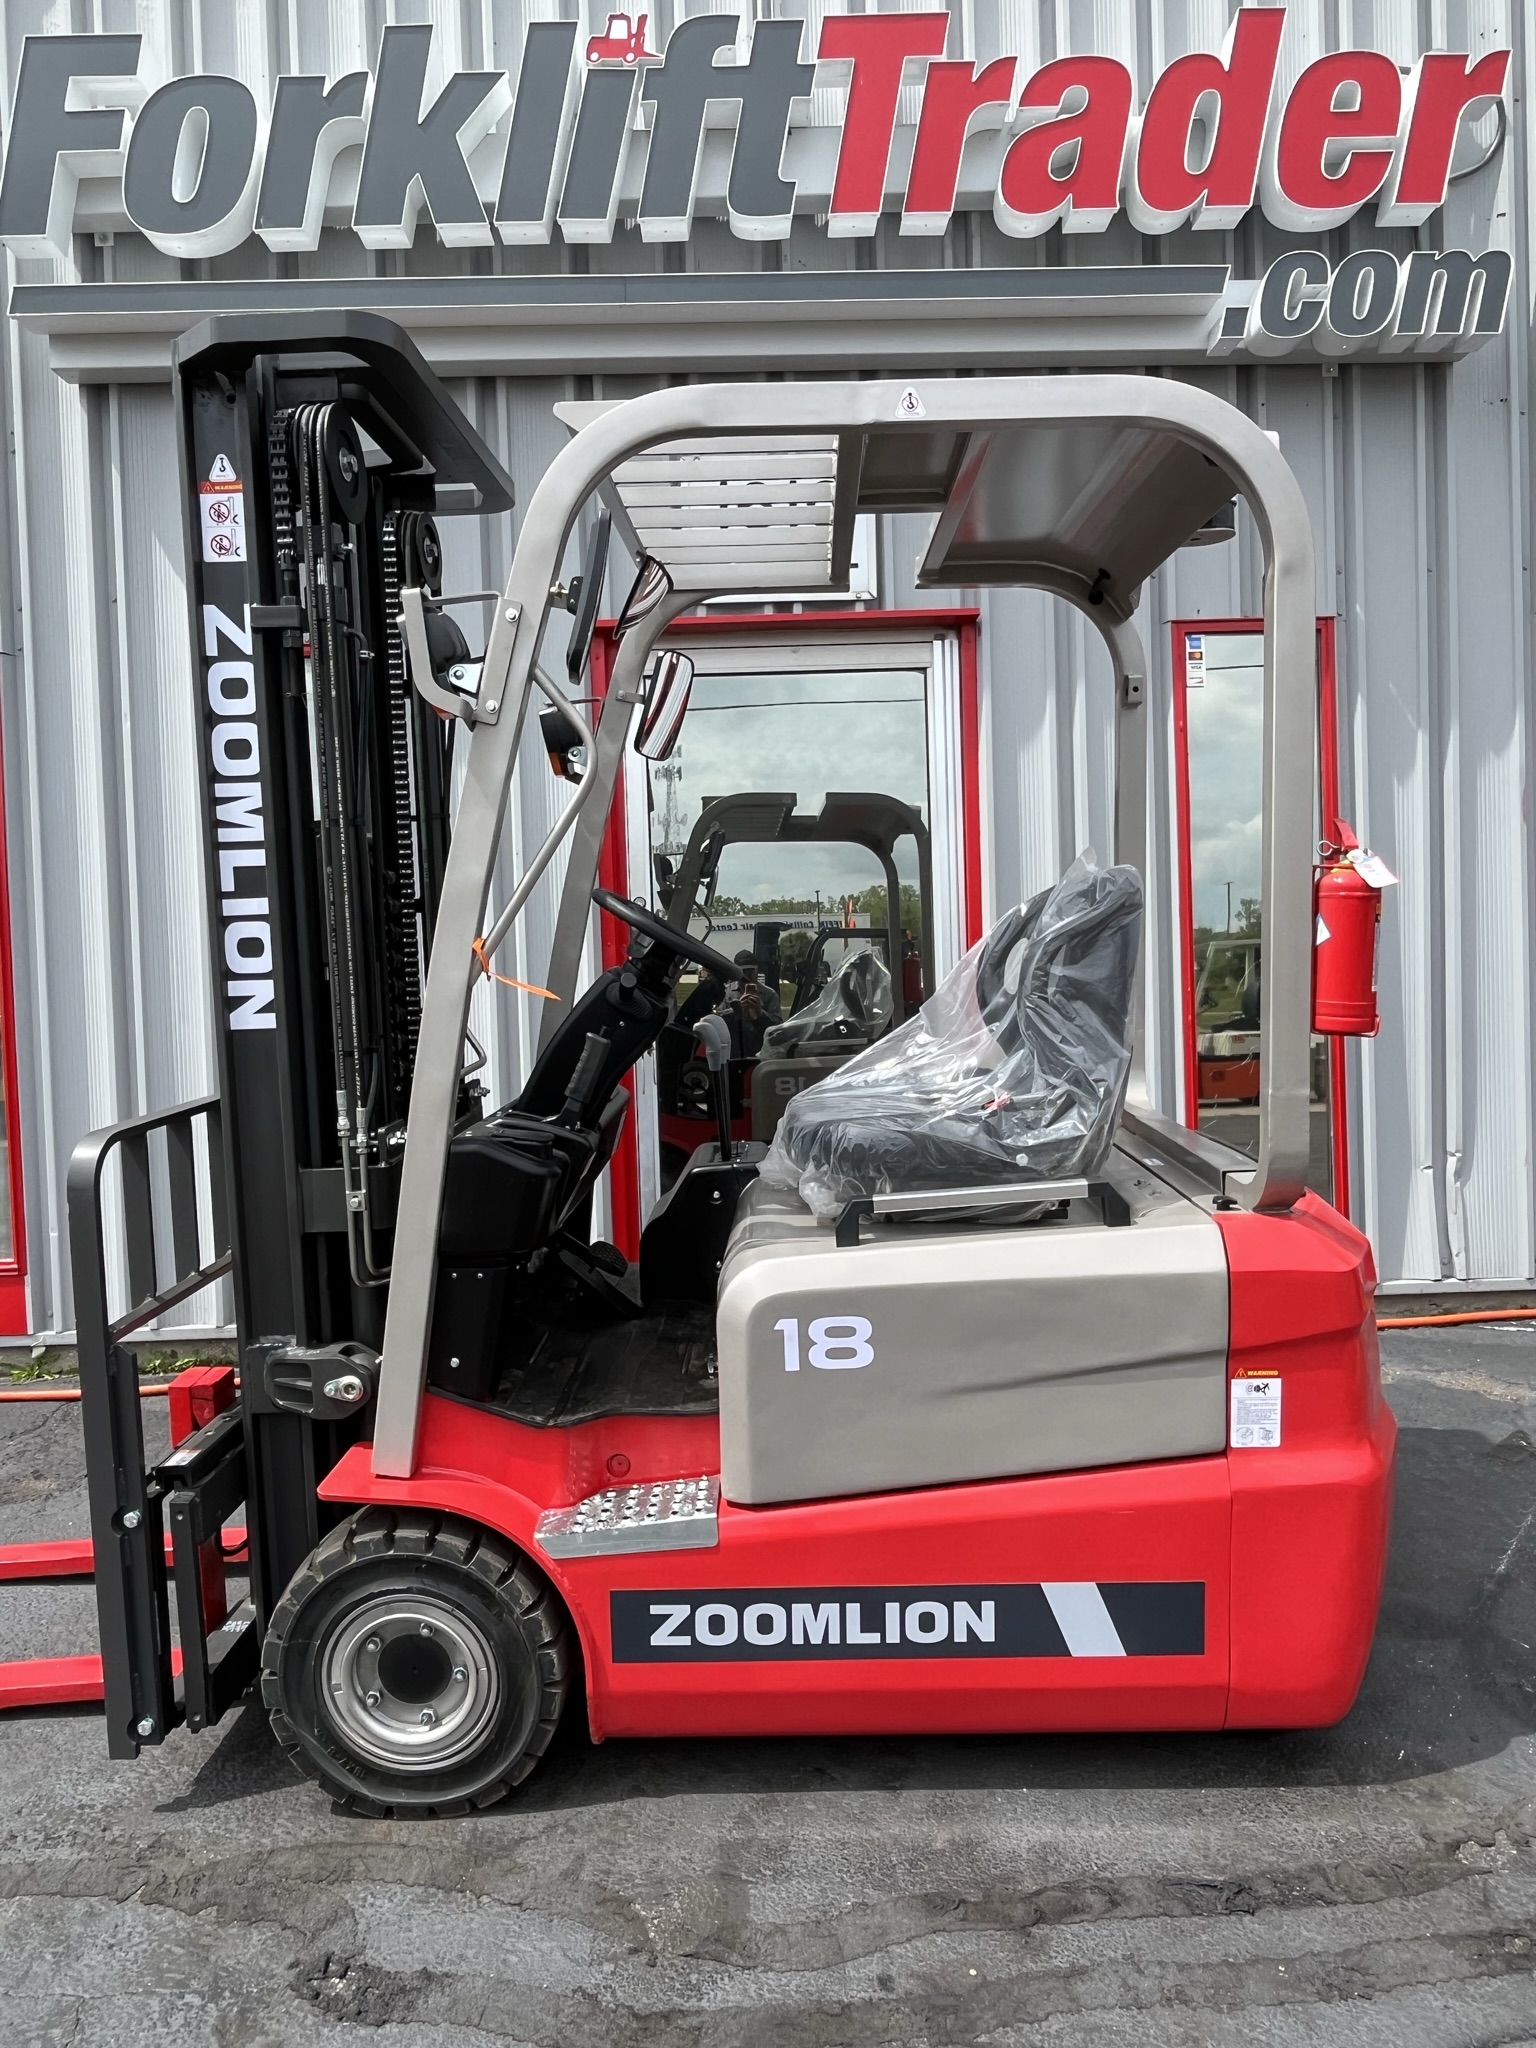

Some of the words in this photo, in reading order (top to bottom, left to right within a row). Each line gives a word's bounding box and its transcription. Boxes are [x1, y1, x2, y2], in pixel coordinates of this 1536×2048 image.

[0, 6, 1512, 240] ForkliftTrader
[1219, 249, 1513, 342] .com
[203, 603, 277, 1030] ZOOMLION
[774, 1315, 874, 1371] 18
[649, 1600, 996, 1646] ZOOMLION
